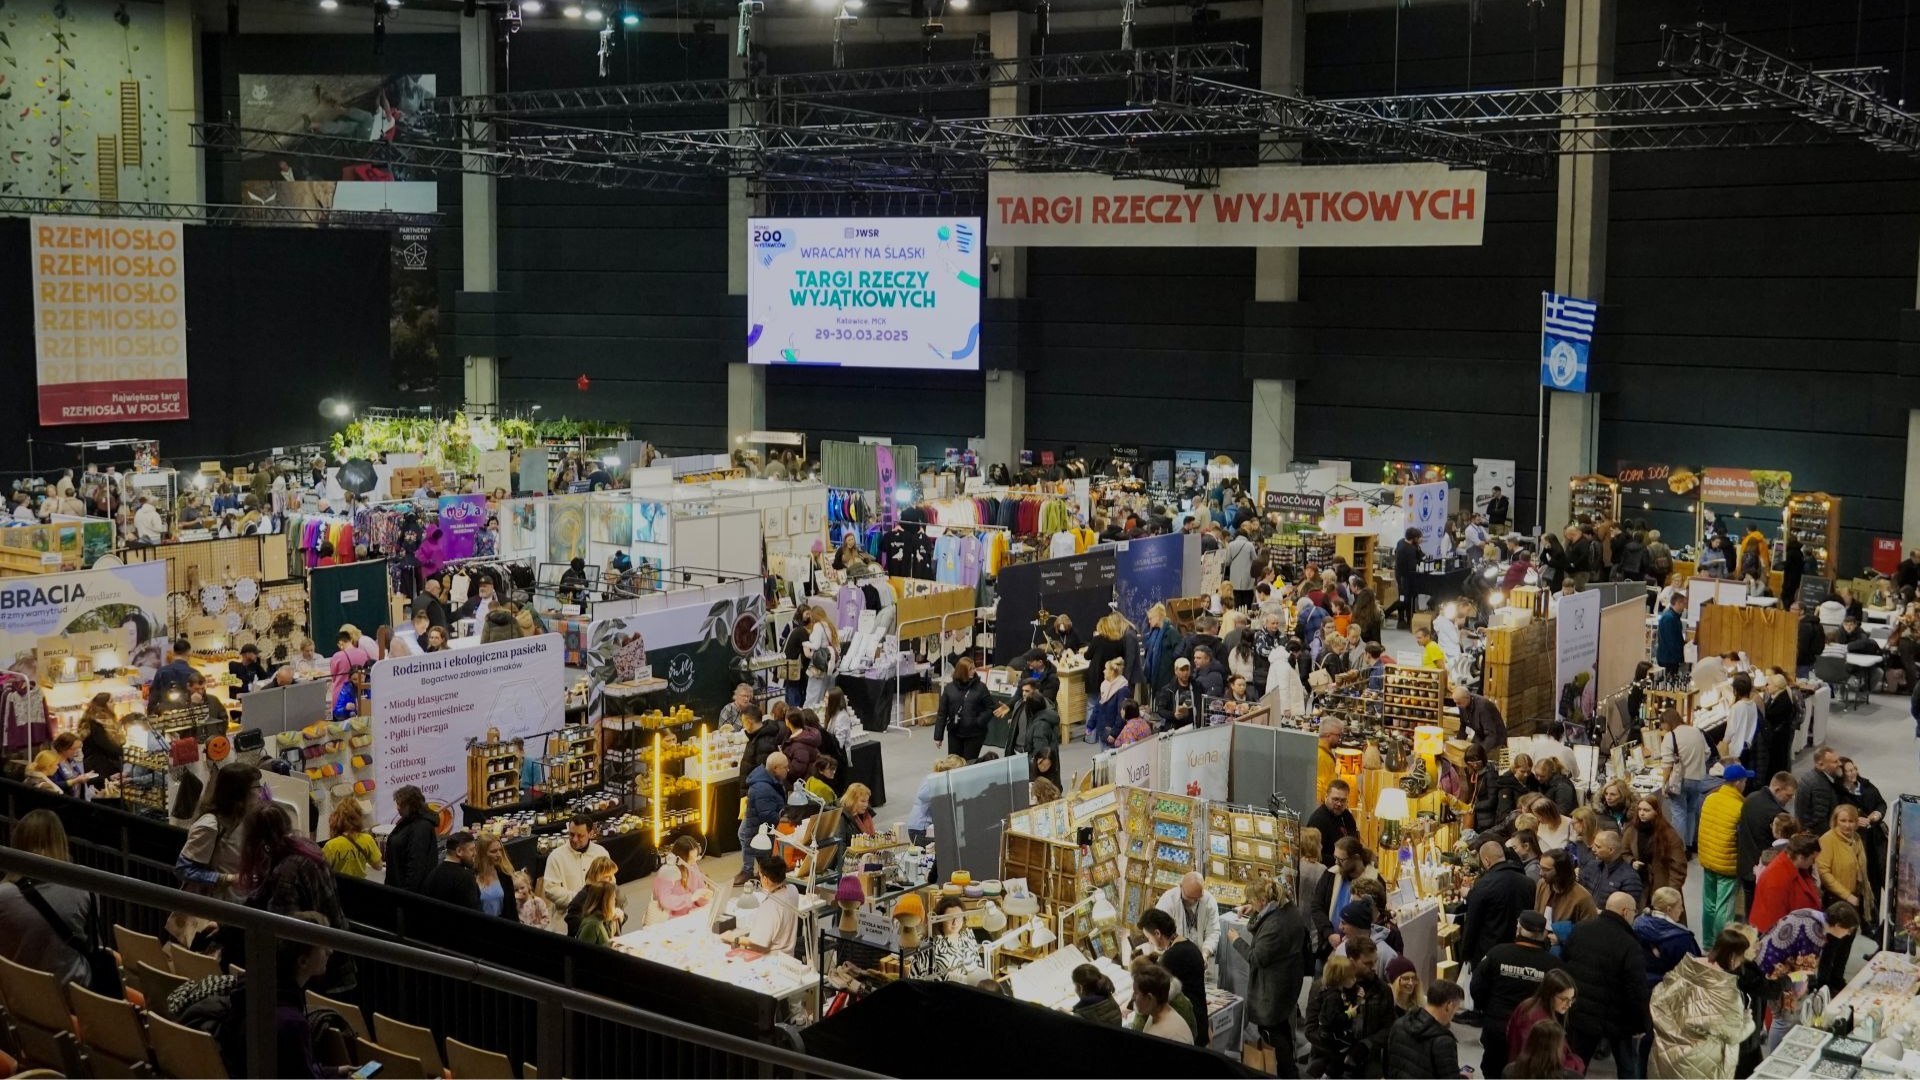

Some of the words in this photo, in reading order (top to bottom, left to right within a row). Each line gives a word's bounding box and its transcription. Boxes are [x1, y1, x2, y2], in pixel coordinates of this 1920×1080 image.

[998, 195, 1082, 225] TARGI
[1092, 194, 1203, 224] RZECZY
[1213, 188, 1475, 229] WYJĄTKOWYCH
[38, 226, 177, 251] RZEMIOSŁO
[754, 231, 782, 242] 200
[855, 229, 880, 238] JWSR
[800, 247, 860, 259] WRACAMY
[865, 248, 881, 259] NA
[885, 245, 925, 261] ŚLĄSK!
[40, 254, 177, 278] RZEMIOSŁO
[796, 270, 853, 288] TARGI
[859, 271, 929, 288] RZECZY
[40, 281, 178, 304] RZEMIOSŁO
[790, 289, 936, 311] WYJĄTKOWYCH
[42, 309, 178, 330] RZEMIOSŁO
[815, 329, 909, 341] 29-30.03.2025
[43, 336, 179, 358] RZEMIOSŁO
[112, 392, 159, 403] Największe
[161, 391, 181, 402] targi
[62, 405, 124, 418] RZEMIOSŁA
[127, 404, 138, 415] W
[140, 402, 181, 414] POLSCE
[1703, 477, 1738, 487] Bubble
[1739, 478, 1755, 488] Tea
[0, 583, 86, 610] BRACIA
[0, 606, 68, 620] #zmywamytrud
[194, 629, 215, 637] BRACIA
[43, 649, 68, 657] BRACIA
[90, 643, 114, 651] BRACIA
[392, 660, 442, 677] Rodzinna
[444, 658, 448, 668] i
[449, 648, 509, 667] ekologiczna
[510, 642, 547, 660] pasieka
[421, 673, 459, 686] Bogactwo
[460, 666, 489, 679] zdrowia
[493, 662, 523, 672] smaków
[389, 696, 416, 709] Miody
[417, 690, 459, 705] klasyczne
[389, 712, 416, 726] Miody
[417, 702, 475, 719] rzemieślnicze
[417, 722, 449, 736] Pierzga
[390, 743, 409, 755] Soki
[390, 756, 426, 770] Giftboxy
[1186, 749, 1219, 768] Yuana
[422, 771, 427, 779] z
[428, 764, 456, 777] wosku
[1126, 763, 1150, 783] Yuana
